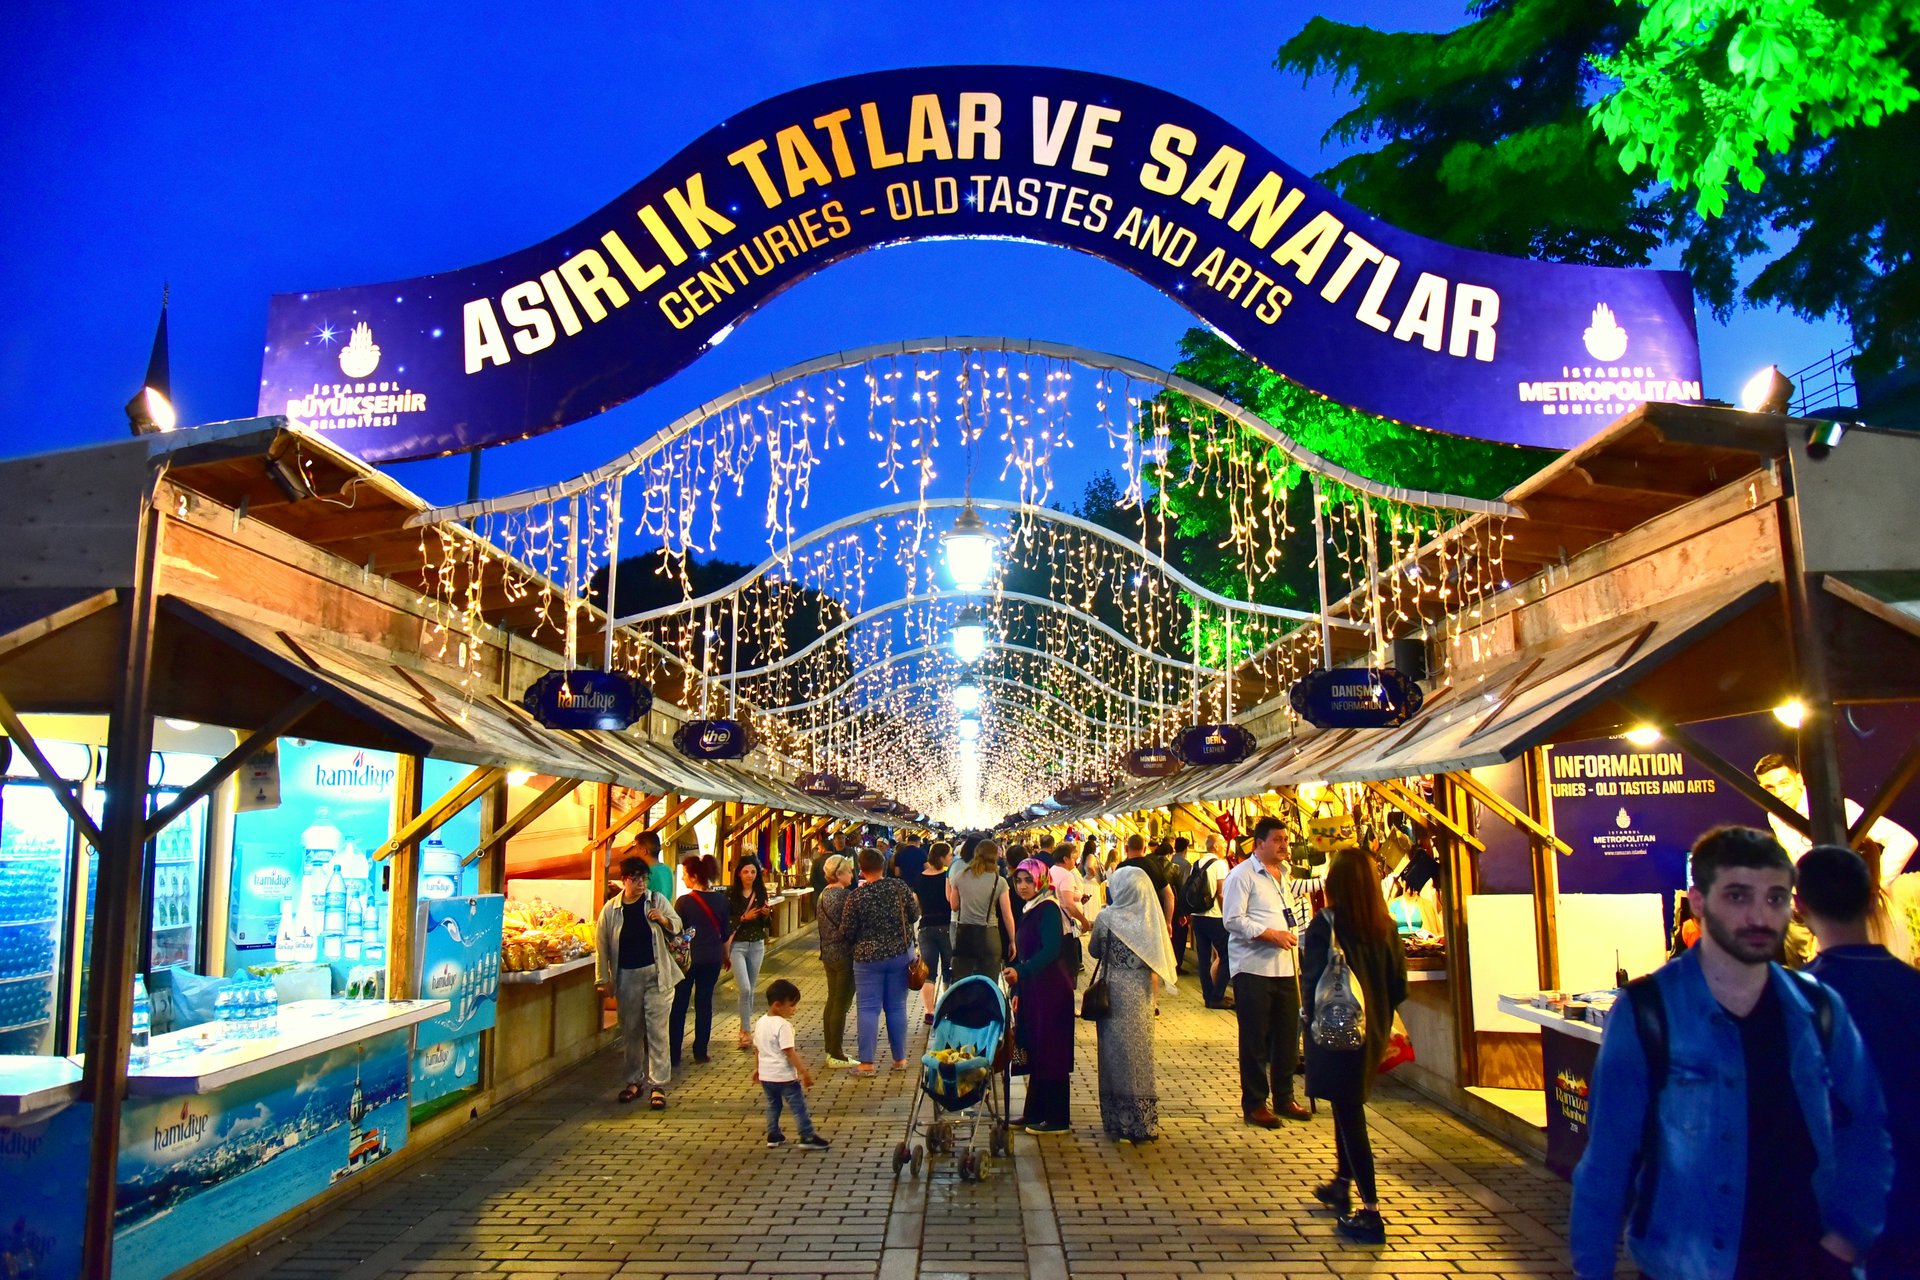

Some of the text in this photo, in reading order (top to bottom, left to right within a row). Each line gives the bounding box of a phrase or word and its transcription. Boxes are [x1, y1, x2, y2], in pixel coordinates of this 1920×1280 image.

[463, 91, 1500, 375] ASIRLIK TATLAR VE SANATLAR
[658, 200, 852, 332] CENTURIES
[886, 175, 959, 221] OLD
[969, 175, 1114, 233] TASTES
[1113, 207, 1199, 268] AND
[1191, 248, 1294, 326] ARTS
[1518, 381, 1701, 401] METROPOLITAN
[557, 690, 616, 713] hamidiye
[1553, 753, 1684, 778] INFORMATION
[315, 764, 395, 794] hamidiye
[1596, 781, 1618, 796] OLD
[1619, 781, 1661, 795] TASTES
[1662, 780, 1685, 794] AND
[1687, 779, 1716, 793] ARTS
[1593, 834, 1656, 844] METROPOLITAN
[254, 874, 291, 889] hamidiye
[153, 1114, 209, 1152] hamidiye
